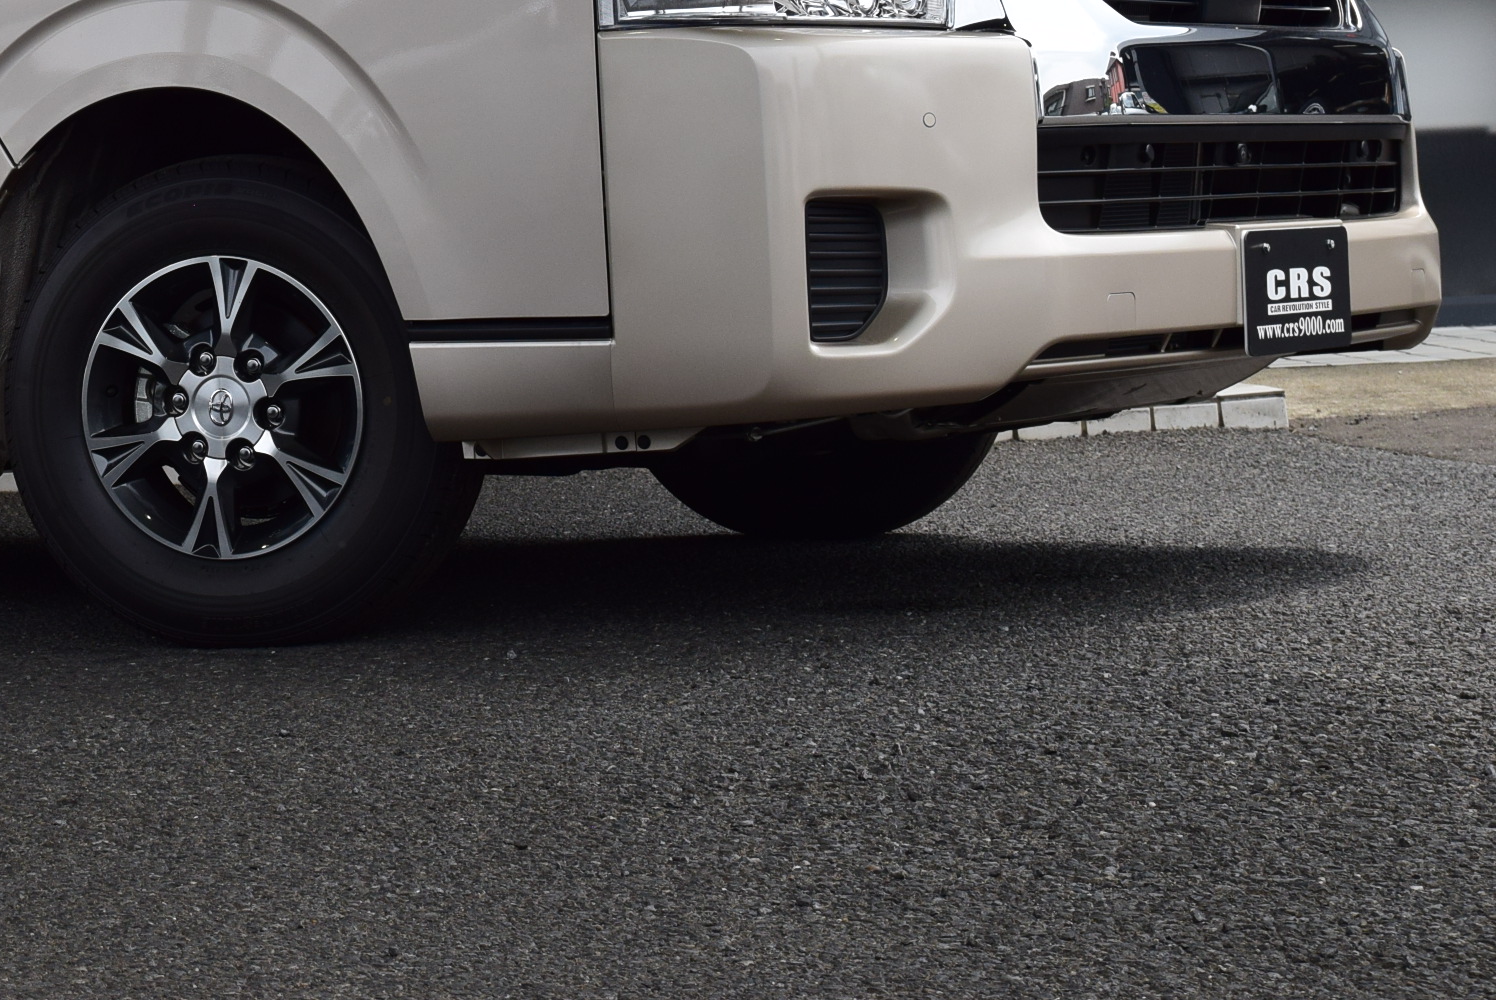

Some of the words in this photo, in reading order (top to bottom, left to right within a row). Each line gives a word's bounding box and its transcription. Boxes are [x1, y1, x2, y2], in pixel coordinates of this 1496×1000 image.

[1267, 266, 1332, 300] CRS
[1270, 305, 1281, 313] CAR
[1282, 302, 1313, 312] REVOLUTION
[1315, 301, 1330, 309] STYLE
[1256, 315, 1345, 340] www.crs9000.com
